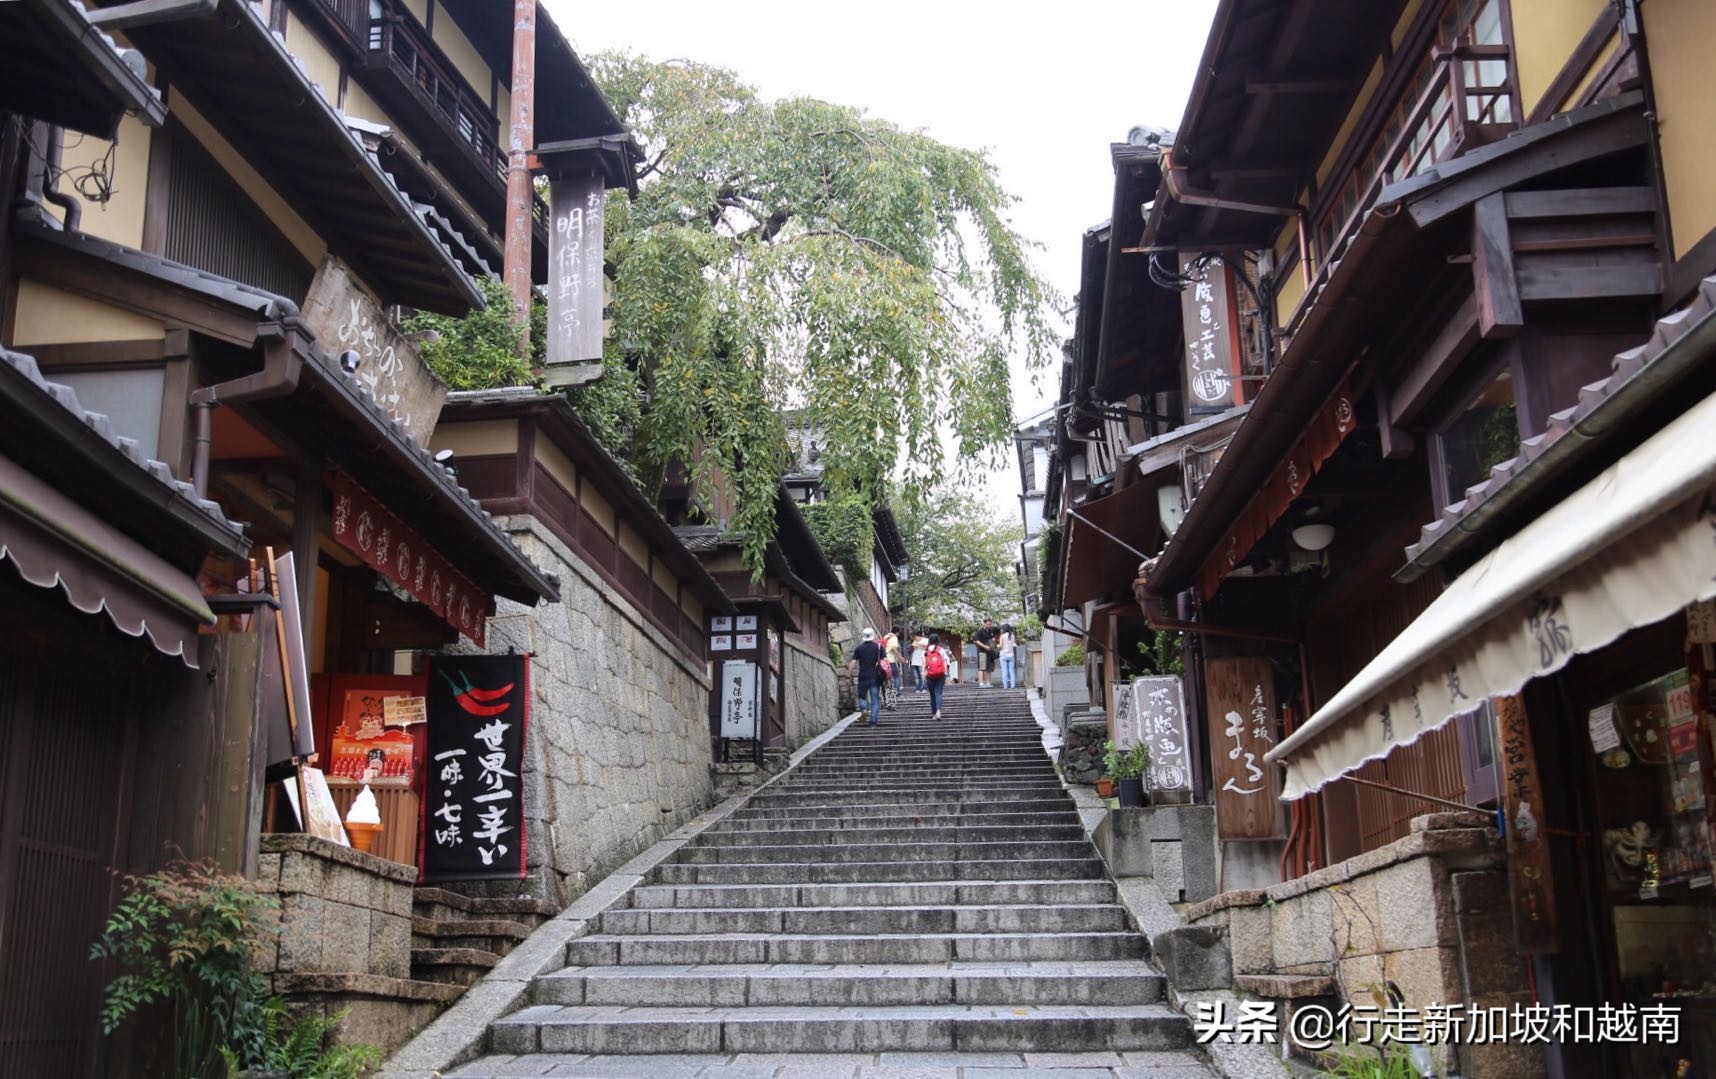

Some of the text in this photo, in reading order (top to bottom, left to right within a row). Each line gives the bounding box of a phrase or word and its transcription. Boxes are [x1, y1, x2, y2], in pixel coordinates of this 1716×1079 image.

[556, 207, 583, 337] 明保野亭
[1222, 710, 1266, 794] まるん
[1250, 684, 1273, 743] 産寧坂
[434, 749, 467, 847] 一味・七味
[472, 718, 519, 866] 世界一辛い
